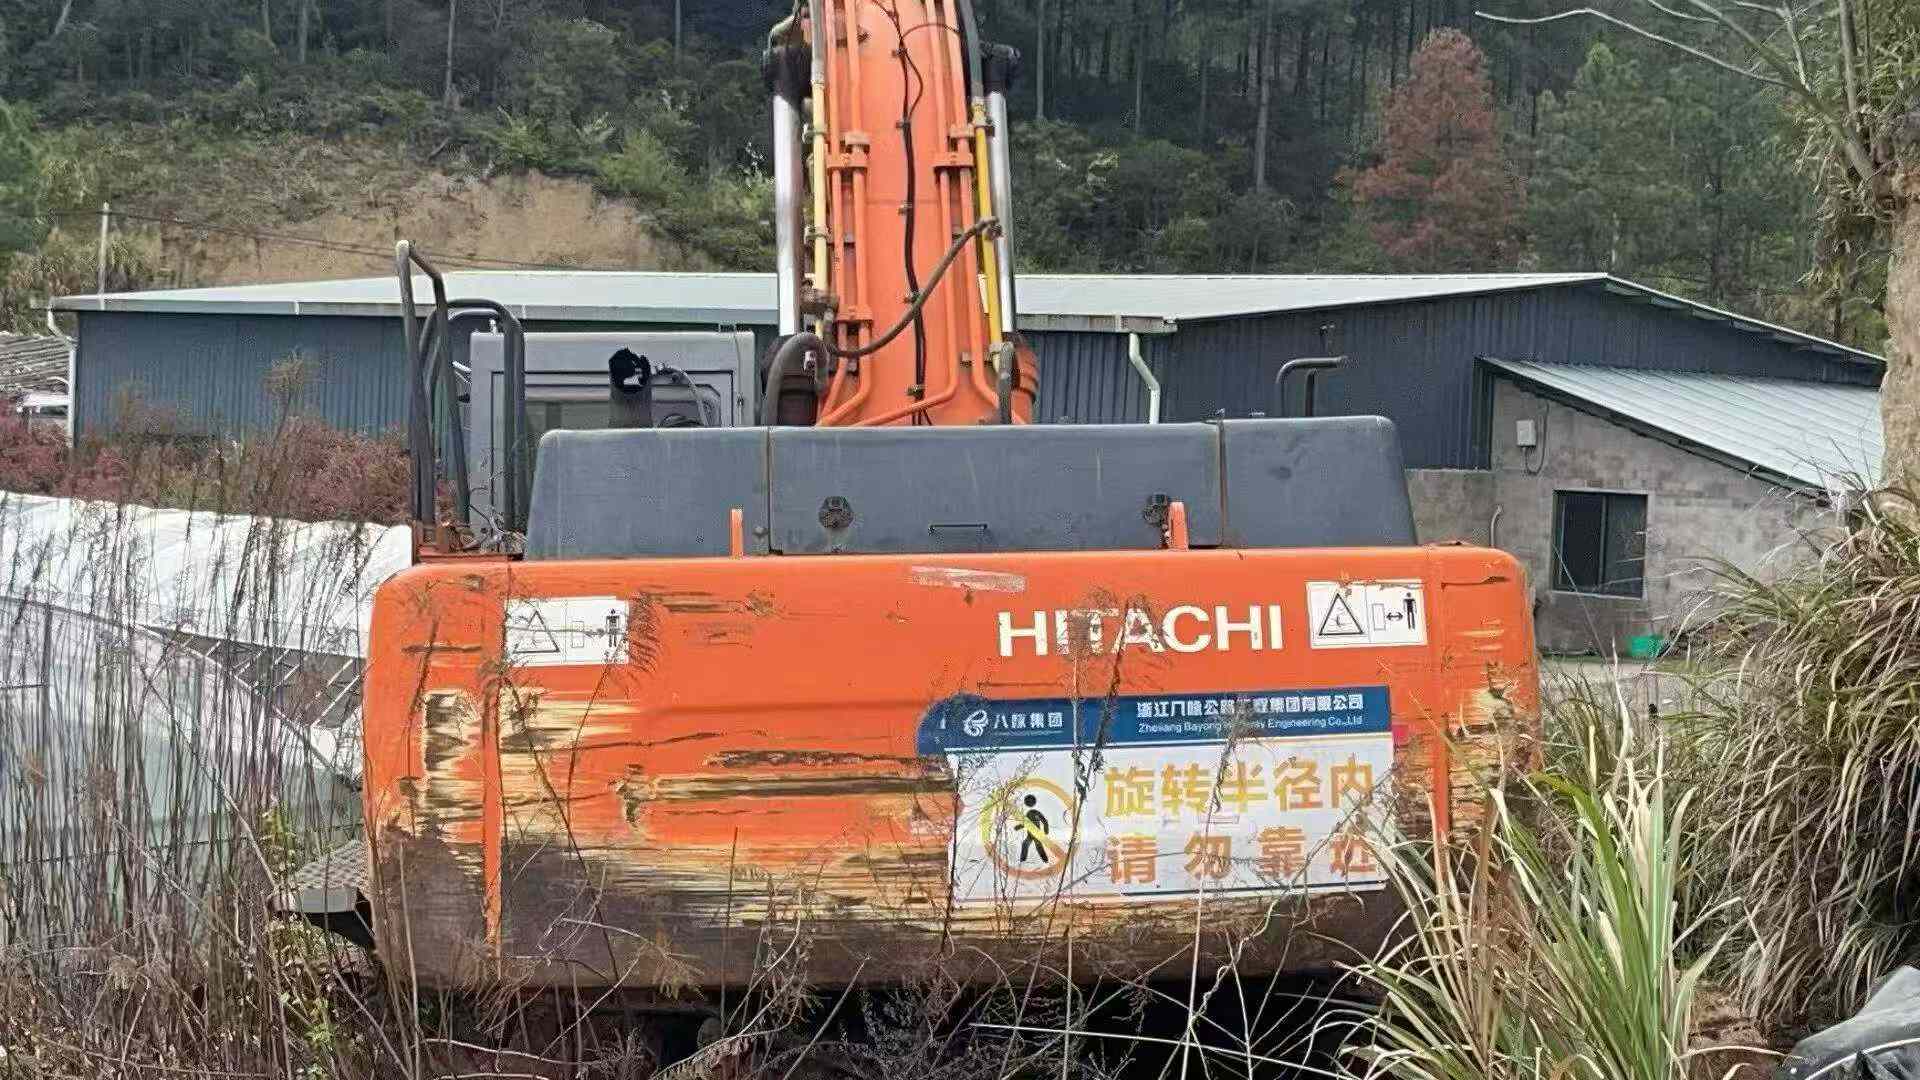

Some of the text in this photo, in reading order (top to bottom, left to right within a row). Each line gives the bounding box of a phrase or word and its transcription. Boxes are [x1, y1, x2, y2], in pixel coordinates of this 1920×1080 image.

[998, 604, 1284, 657] HITACHI
[1267, 717, 1327, 730] Engineering
[1104, 753, 1374, 817] 旋转半径内
